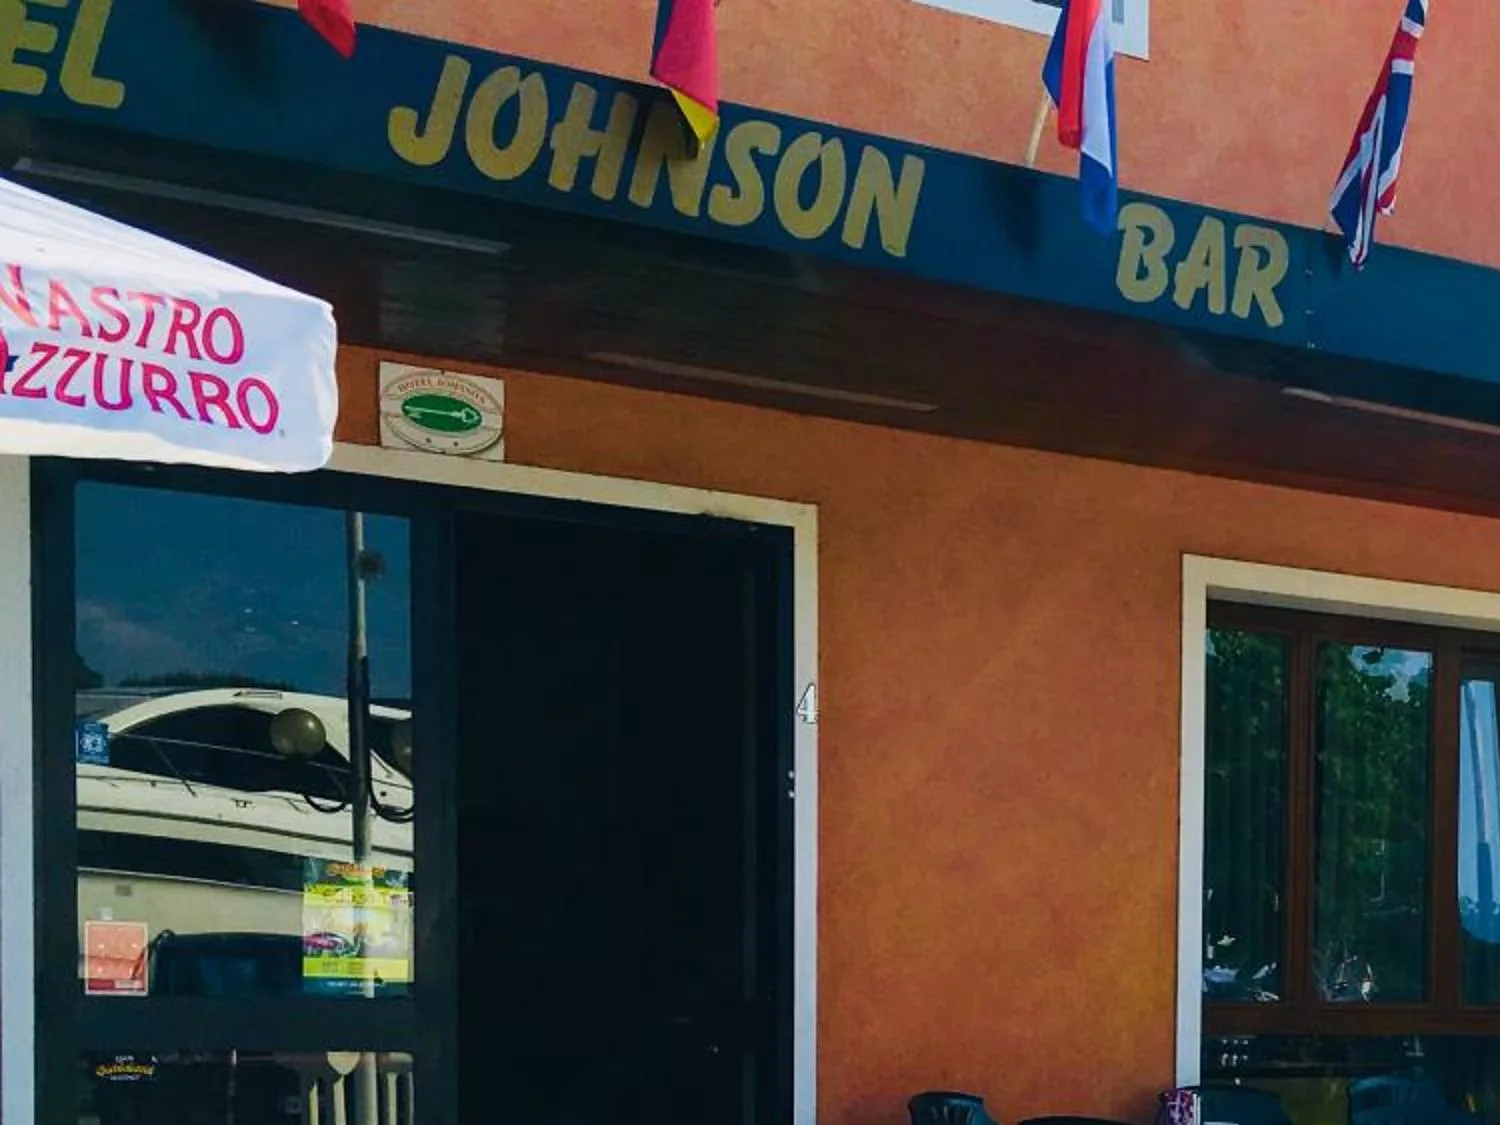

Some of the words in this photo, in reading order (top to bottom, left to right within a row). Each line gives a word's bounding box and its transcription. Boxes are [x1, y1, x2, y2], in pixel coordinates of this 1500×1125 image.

[388, 54, 926, 258] JOHNSON
[1116, 202, 1290, 328] BAR
[0, 262, 245, 365] NASTRO
